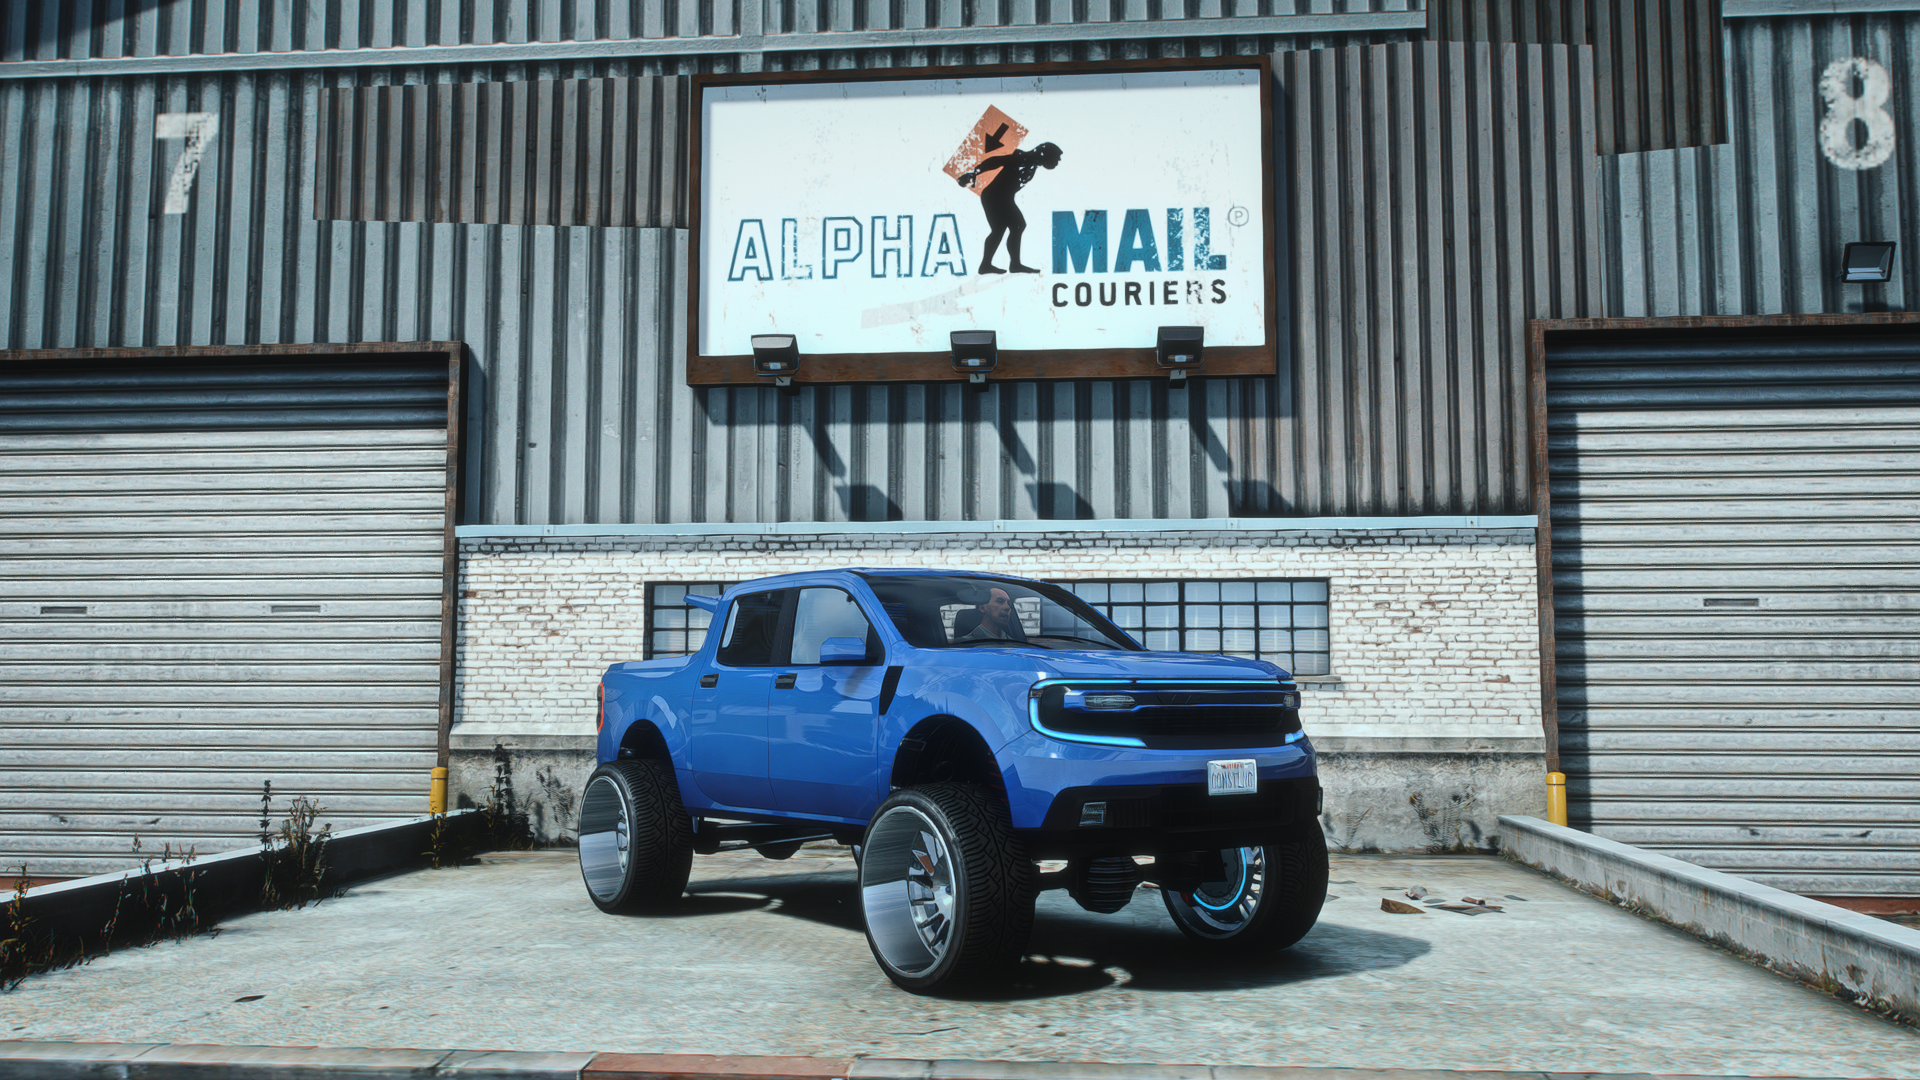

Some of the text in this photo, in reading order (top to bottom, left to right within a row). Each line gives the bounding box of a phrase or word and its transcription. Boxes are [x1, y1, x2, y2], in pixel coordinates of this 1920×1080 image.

[1818, 57, 1895, 171] 8
[155, 111, 219, 215] 7
[727, 213, 968, 282] ALPHA
[1051, 206, 1227, 275] MAIL
[1051, 278, 1228, 308] COURIERS
